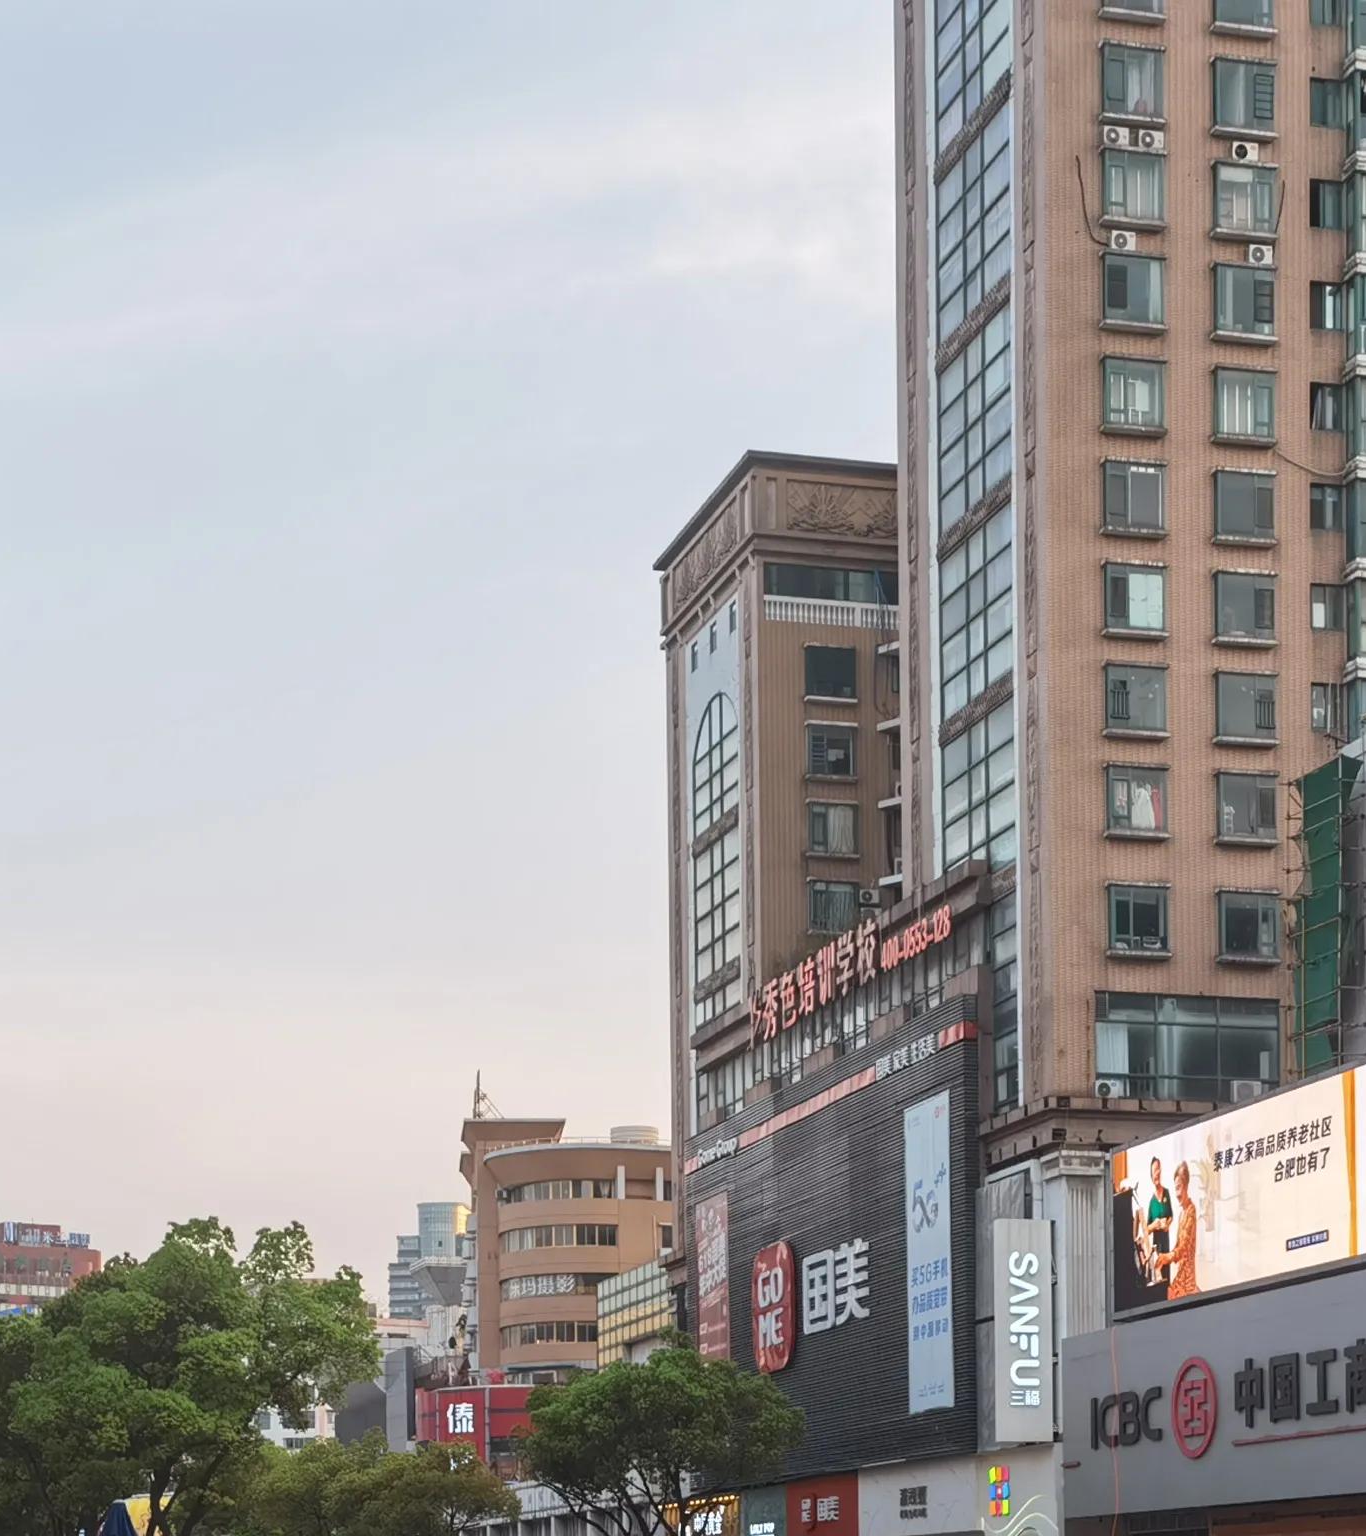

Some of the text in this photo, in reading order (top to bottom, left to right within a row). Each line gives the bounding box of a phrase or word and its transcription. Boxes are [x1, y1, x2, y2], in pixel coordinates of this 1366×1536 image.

[1212, 1116, 1332, 1172] 泰康之家高品质养老社区
[1273, 1147, 1331, 1183] 合肥也有了
[757, 1272, 784, 1308] GO
[802, 1238, 871, 1336] 国美
[757, 1310, 784, 1350] ME
[447, 1402, 475, 1434] 傣
[1090, 1385, 1163, 1450] ICBC
